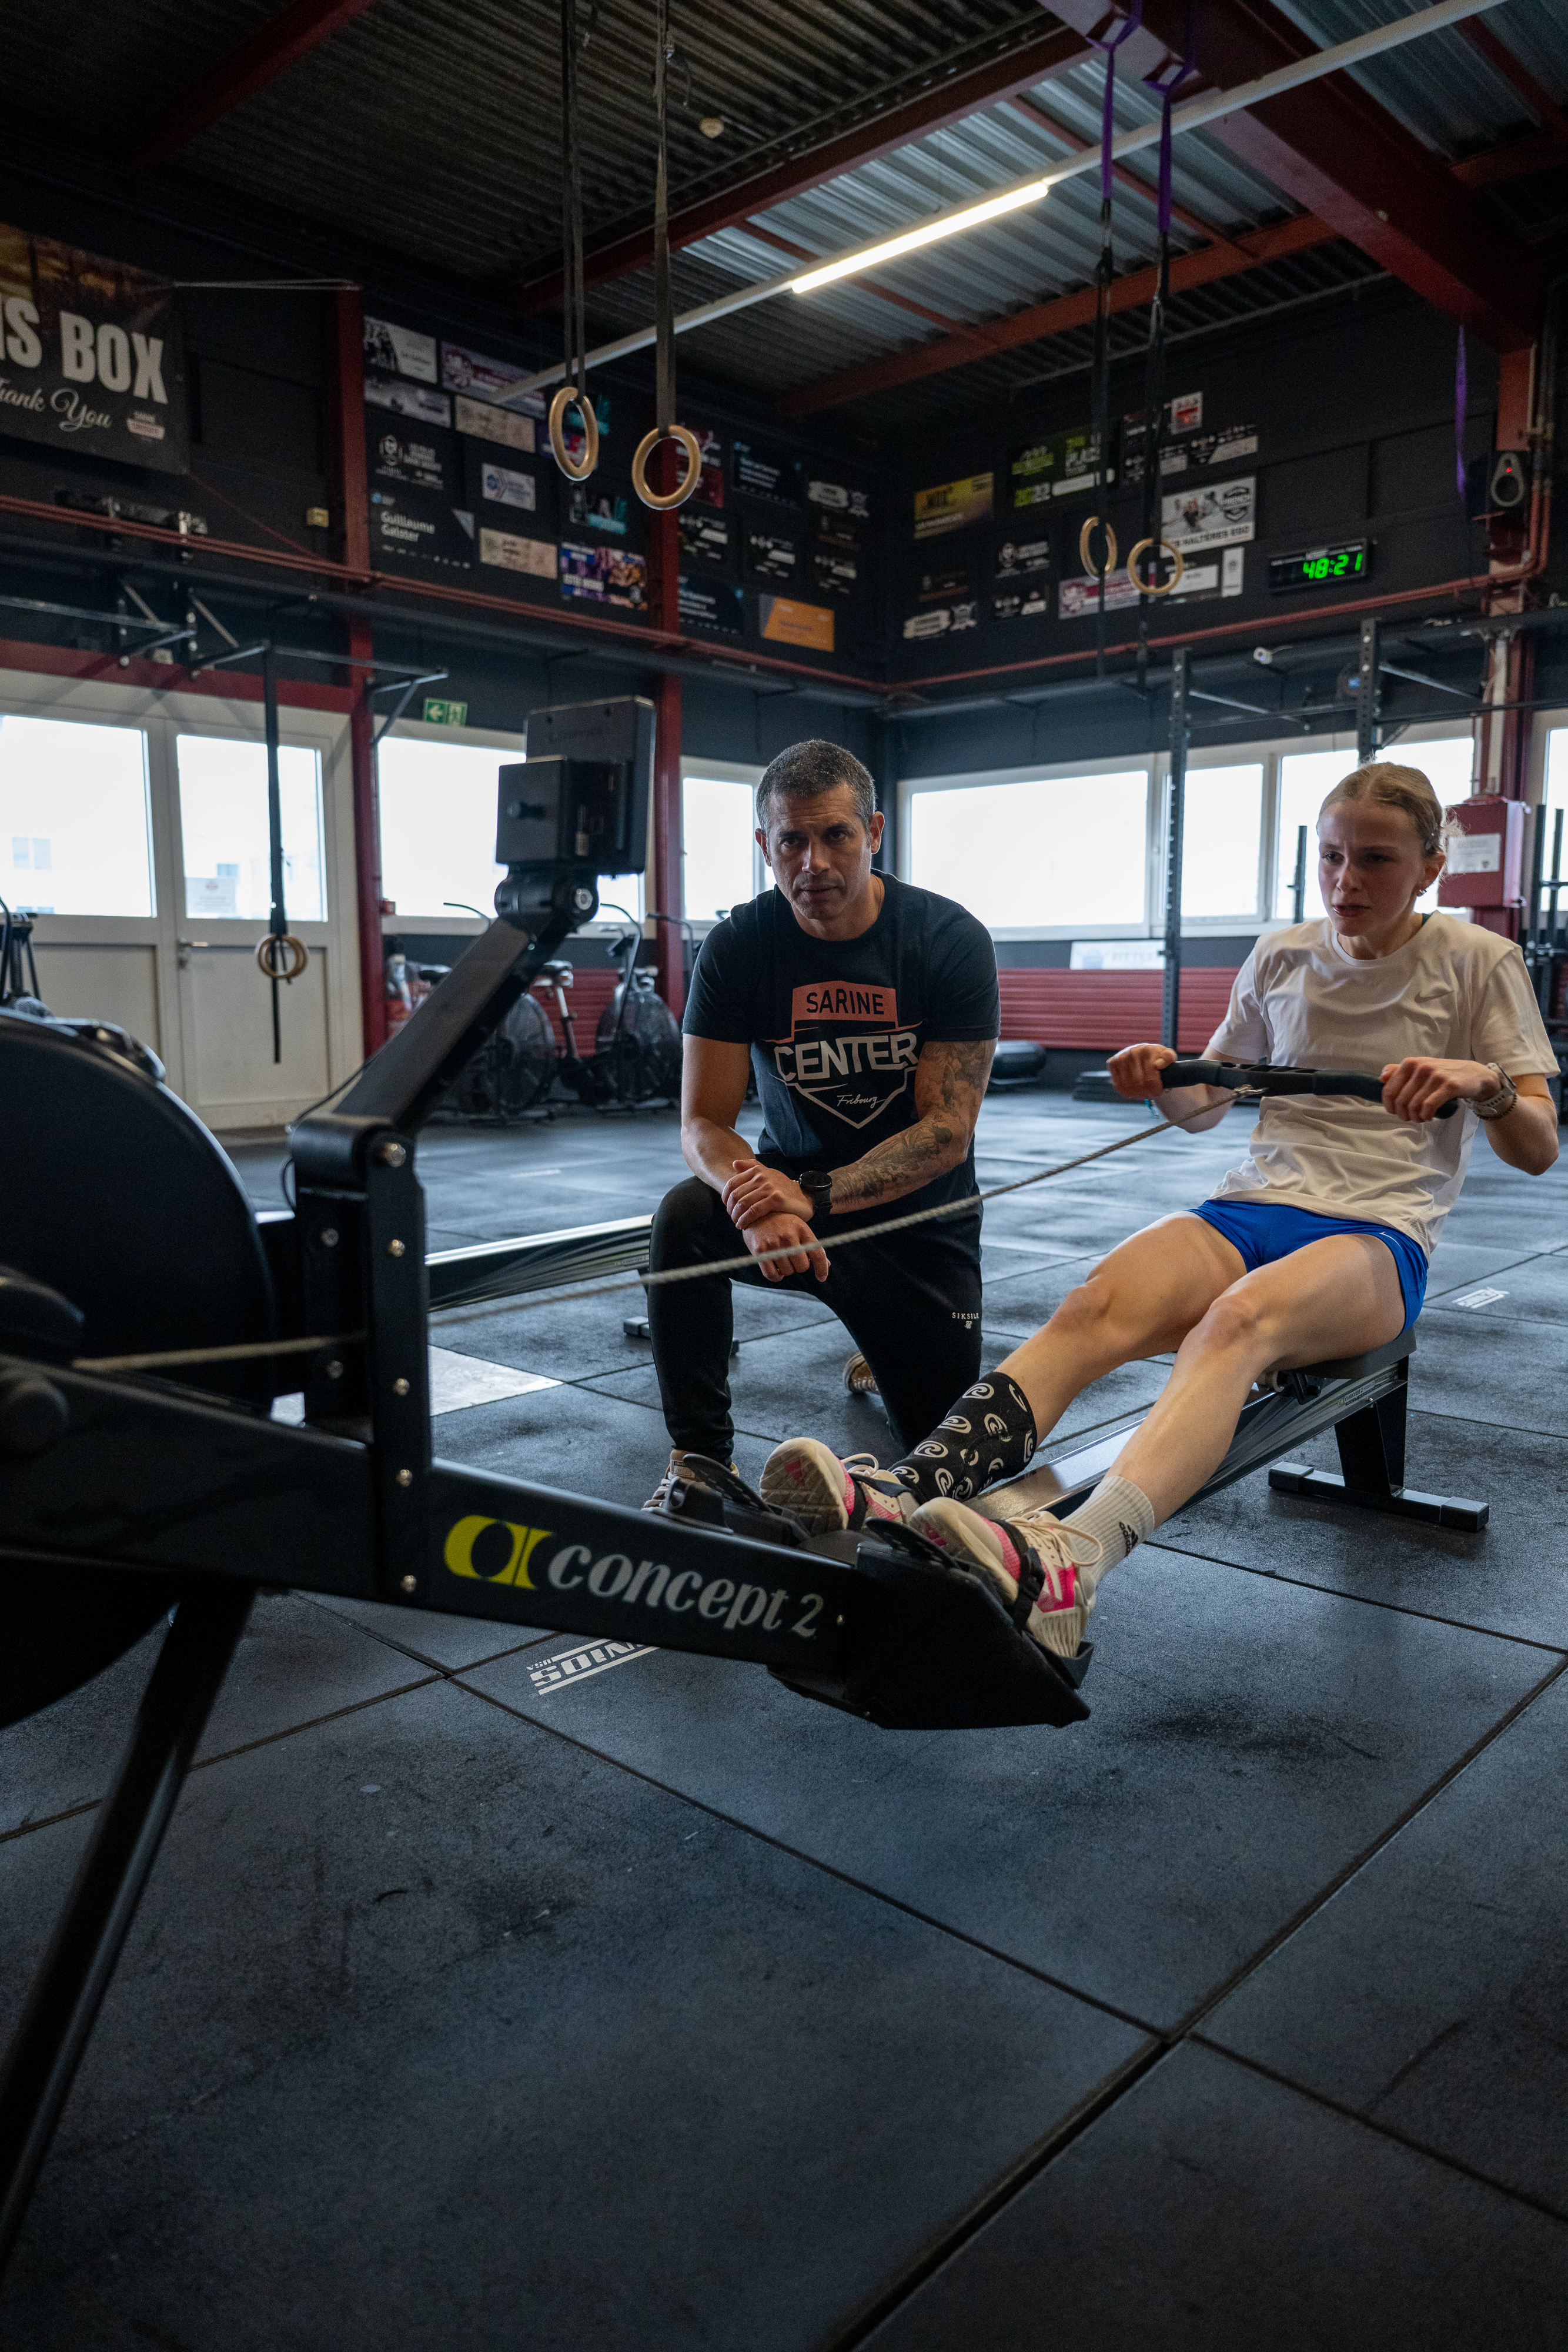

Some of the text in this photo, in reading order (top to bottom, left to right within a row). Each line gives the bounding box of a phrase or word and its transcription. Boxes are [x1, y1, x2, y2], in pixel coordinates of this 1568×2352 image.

[59, 310, 168, 405] BOX
[50, 387, 112, 432] You
[1303, 553, 1363, 579] 48:21
[806, 989, 884, 1015] SARINE
[774, 1032, 919, 1081] CENTER
[837, 1094, 887, 1108] Fribourg
[547, 1545, 824, 1637] concept 2
[526, 1659, 551, 1671] USA
